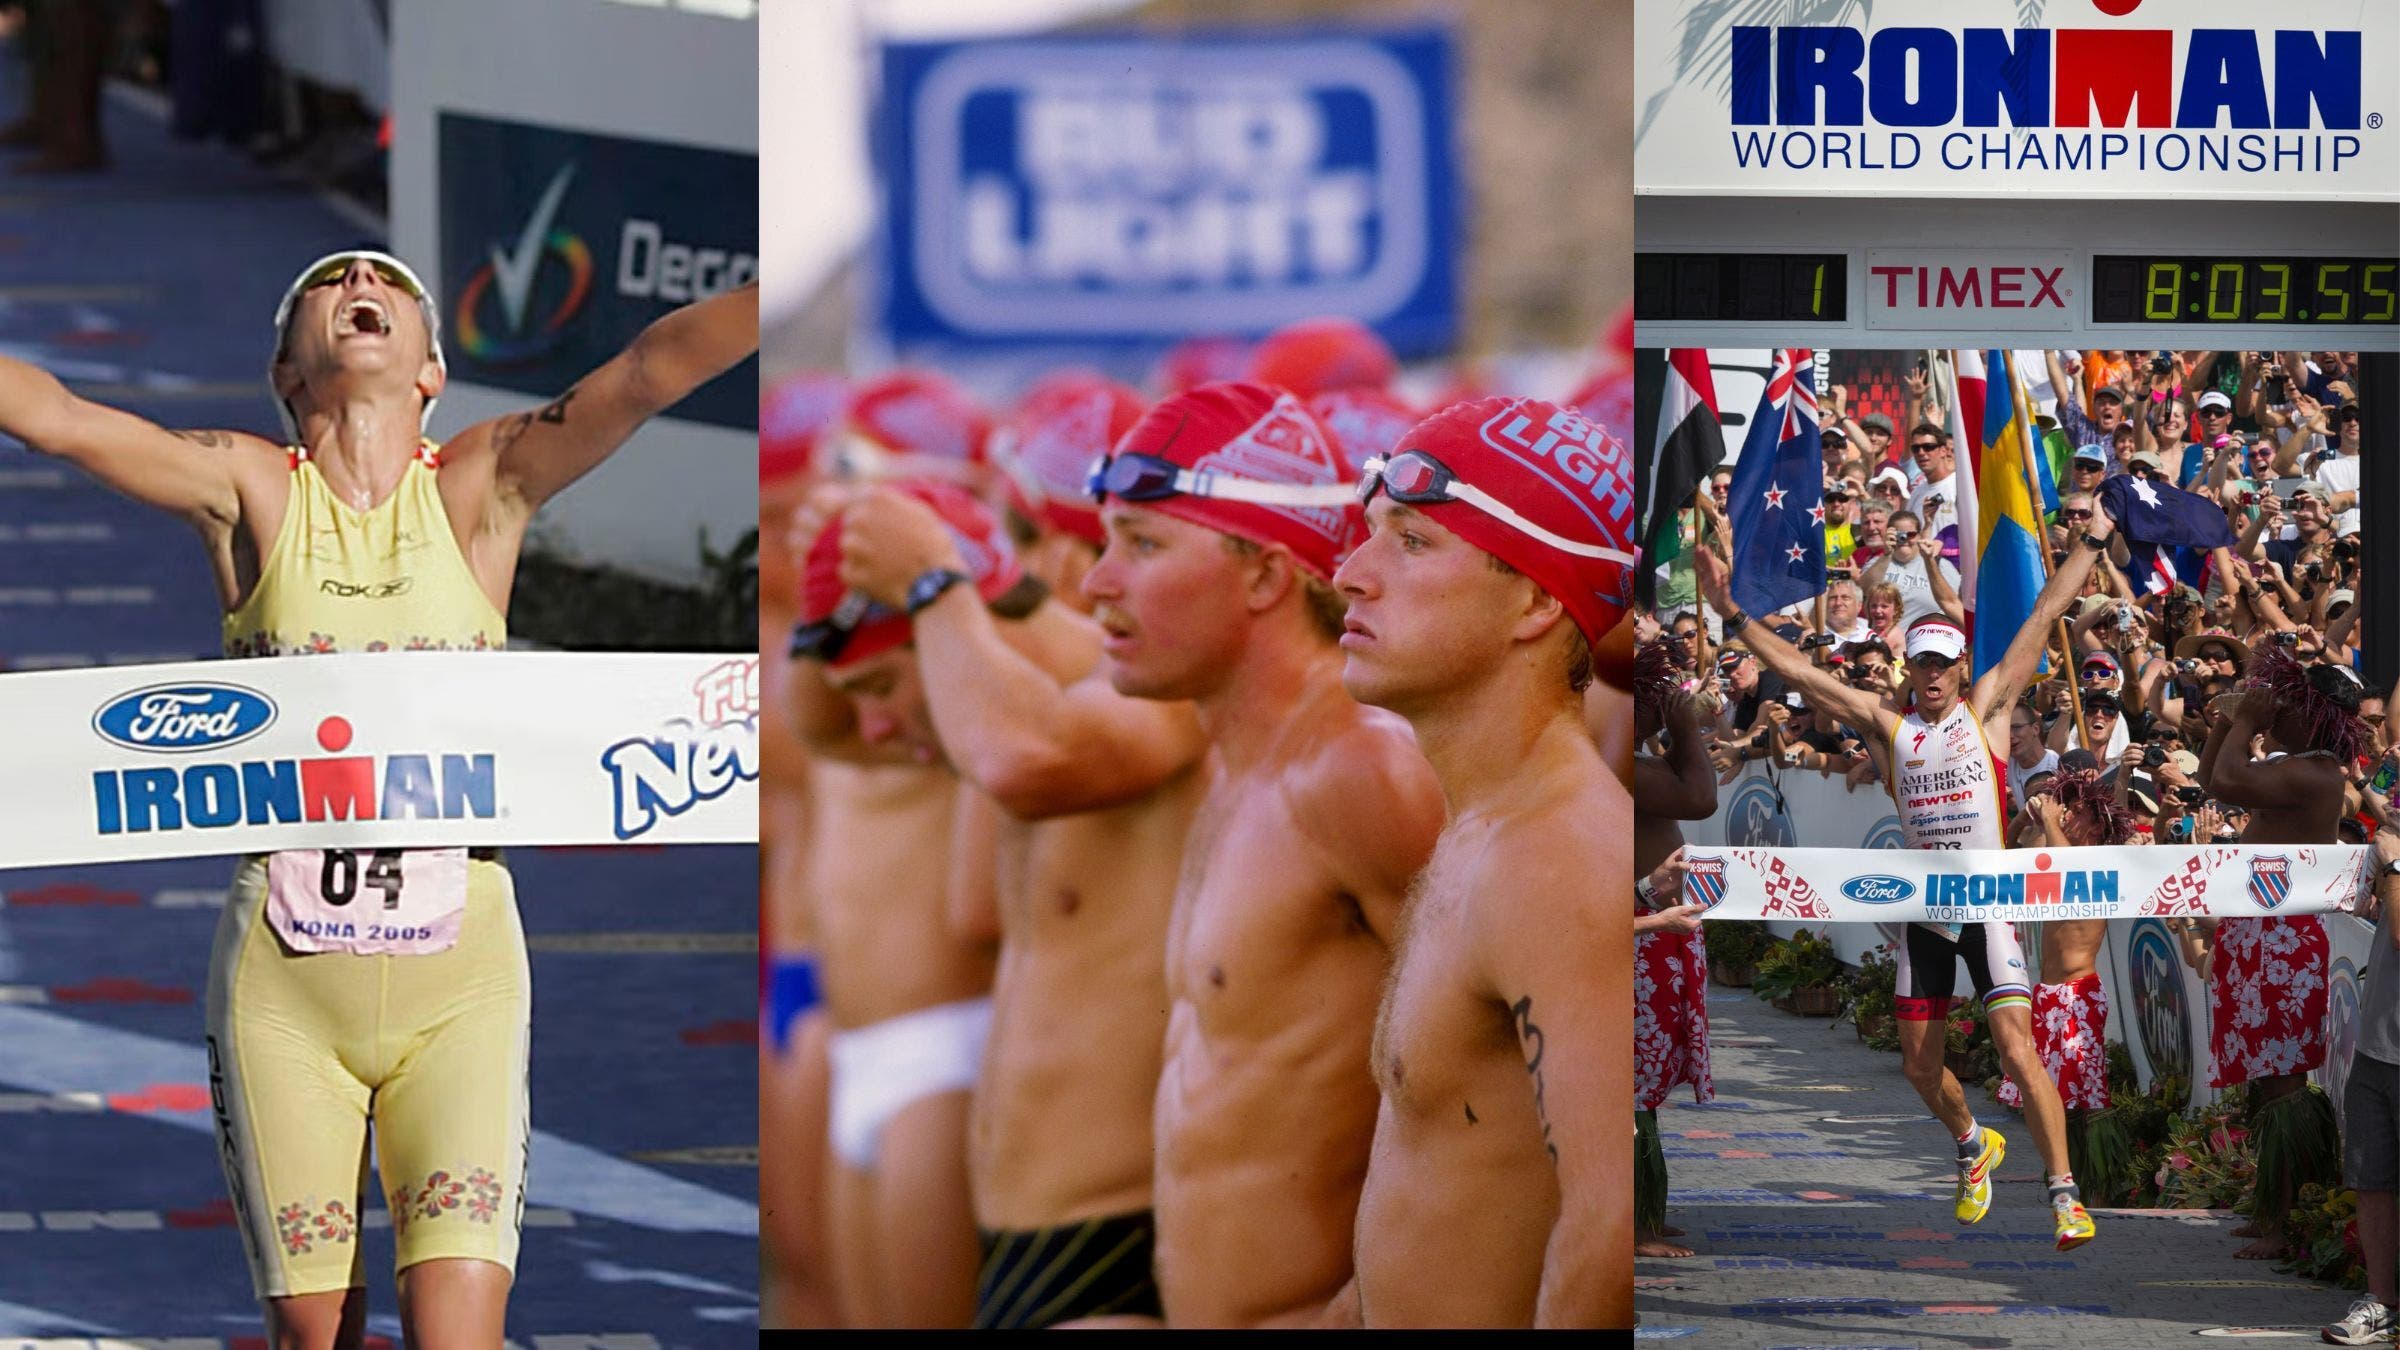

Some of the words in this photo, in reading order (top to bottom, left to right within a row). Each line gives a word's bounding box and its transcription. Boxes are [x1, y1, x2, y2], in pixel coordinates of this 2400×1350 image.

[1732, 25, 2362, 130] IRONMAN
[1028, 86, 1325, 174] BUD
[1732, 131, 1921, 170] WORLD
[1941, 132, 2361, 172] CHAMPIONSHIP
[966, 174, 1374, 282] LIGHT
[1811, 263, 1824, 317] 1
[1871, 266, 2066, 308] TIMEX
[1499, 414, 1634, 544] LIGH
[129, 692, 241, 741] Ford
[1900, 770, 1987, 797] INTERBANC
[1901, 760, 1983, 786] AMERICAN
[92, 753, 496, 836] IRONMAN
[1907, 790, 1973, 809] NEWTON
[1916, 825, 1972, 838] SHIMANO
[1934, 841, 1962, 849] TYR
[1855, 878, 1902, 900] Ford
[1925, 870, 2119, 907] IRONMAN
[292, 919, 356, 939] KONA
[367, 924, 432, 941] 2005
[1925, 906, 1987, 921] WORLD
[1992, 903, 2119, 920] CHAMPIONSHIP
